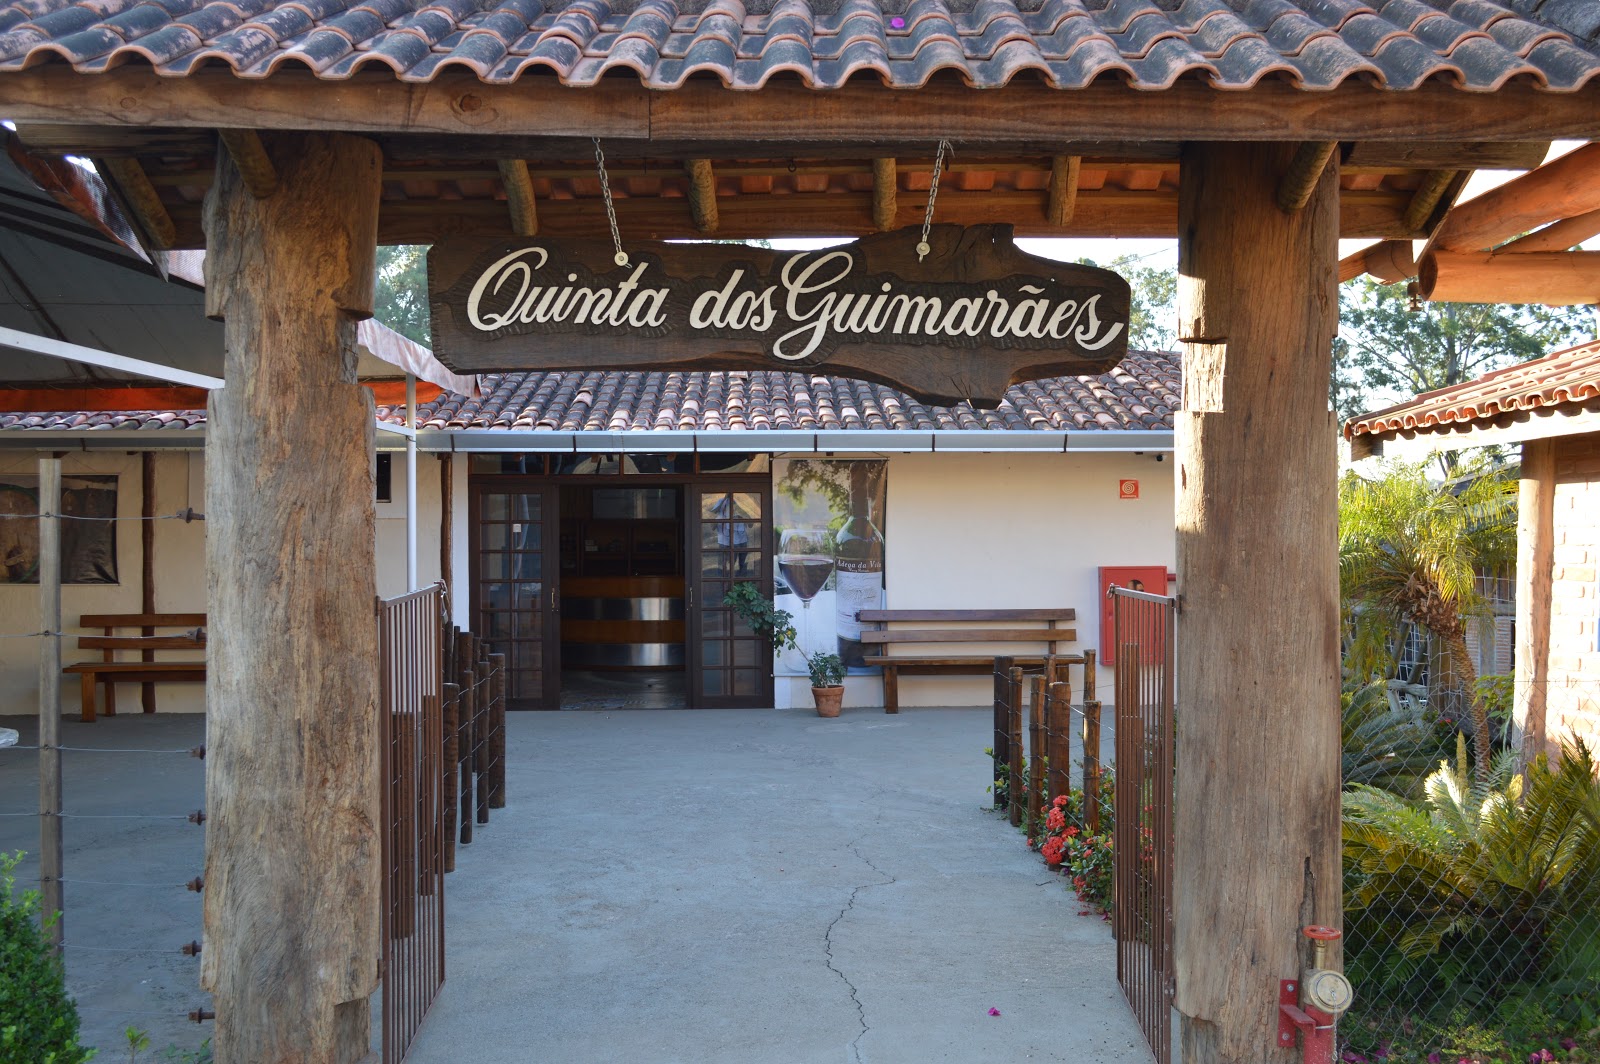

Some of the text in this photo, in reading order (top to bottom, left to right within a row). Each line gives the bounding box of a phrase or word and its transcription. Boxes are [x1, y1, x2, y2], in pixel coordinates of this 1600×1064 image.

[467, 246, 1124, 361] Quinta dos Guimarães
